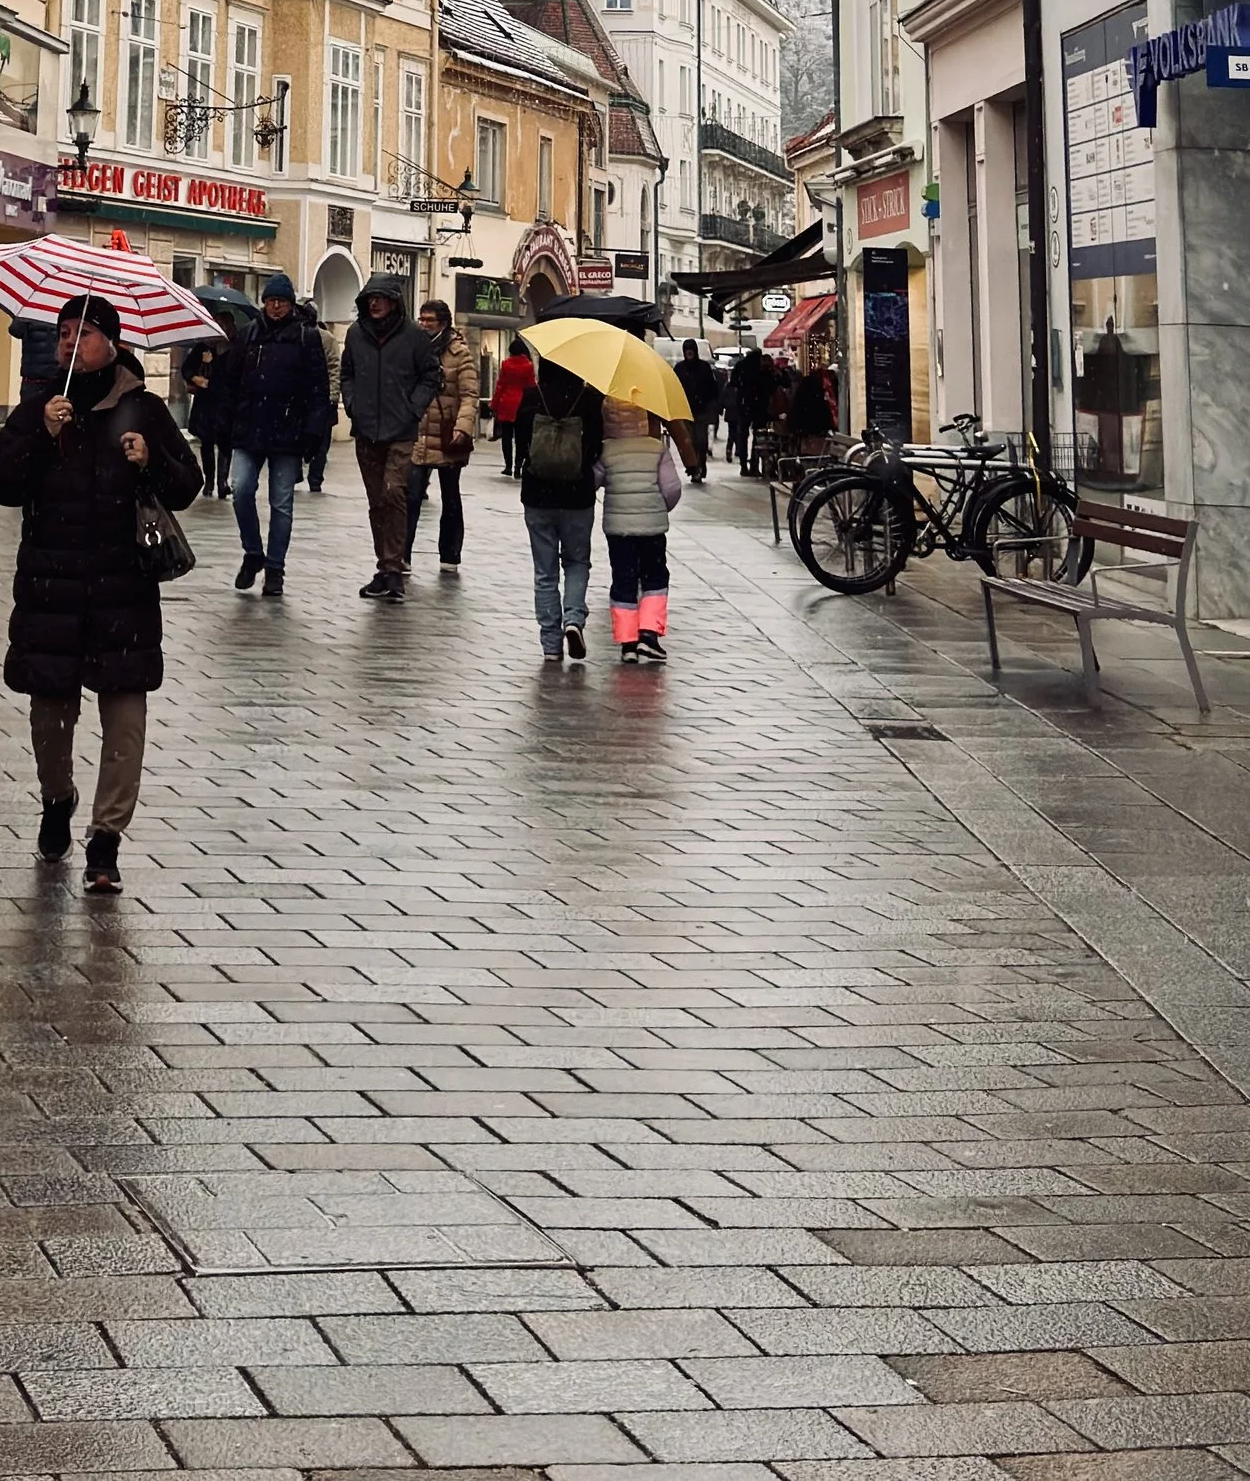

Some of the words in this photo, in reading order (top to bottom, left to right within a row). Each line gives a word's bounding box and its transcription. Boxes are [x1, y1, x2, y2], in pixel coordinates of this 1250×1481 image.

[1150, 3, 1241, 80] VOLKSBANK
[1235, 62, 1249, 72] SB
[133, 170, 182, 202] GEIST
[187, 179, 267, 216] APOTHEKE
[413, 202, 455, 212] SCHUHE
[588, 271, 612, 279] GRECO
